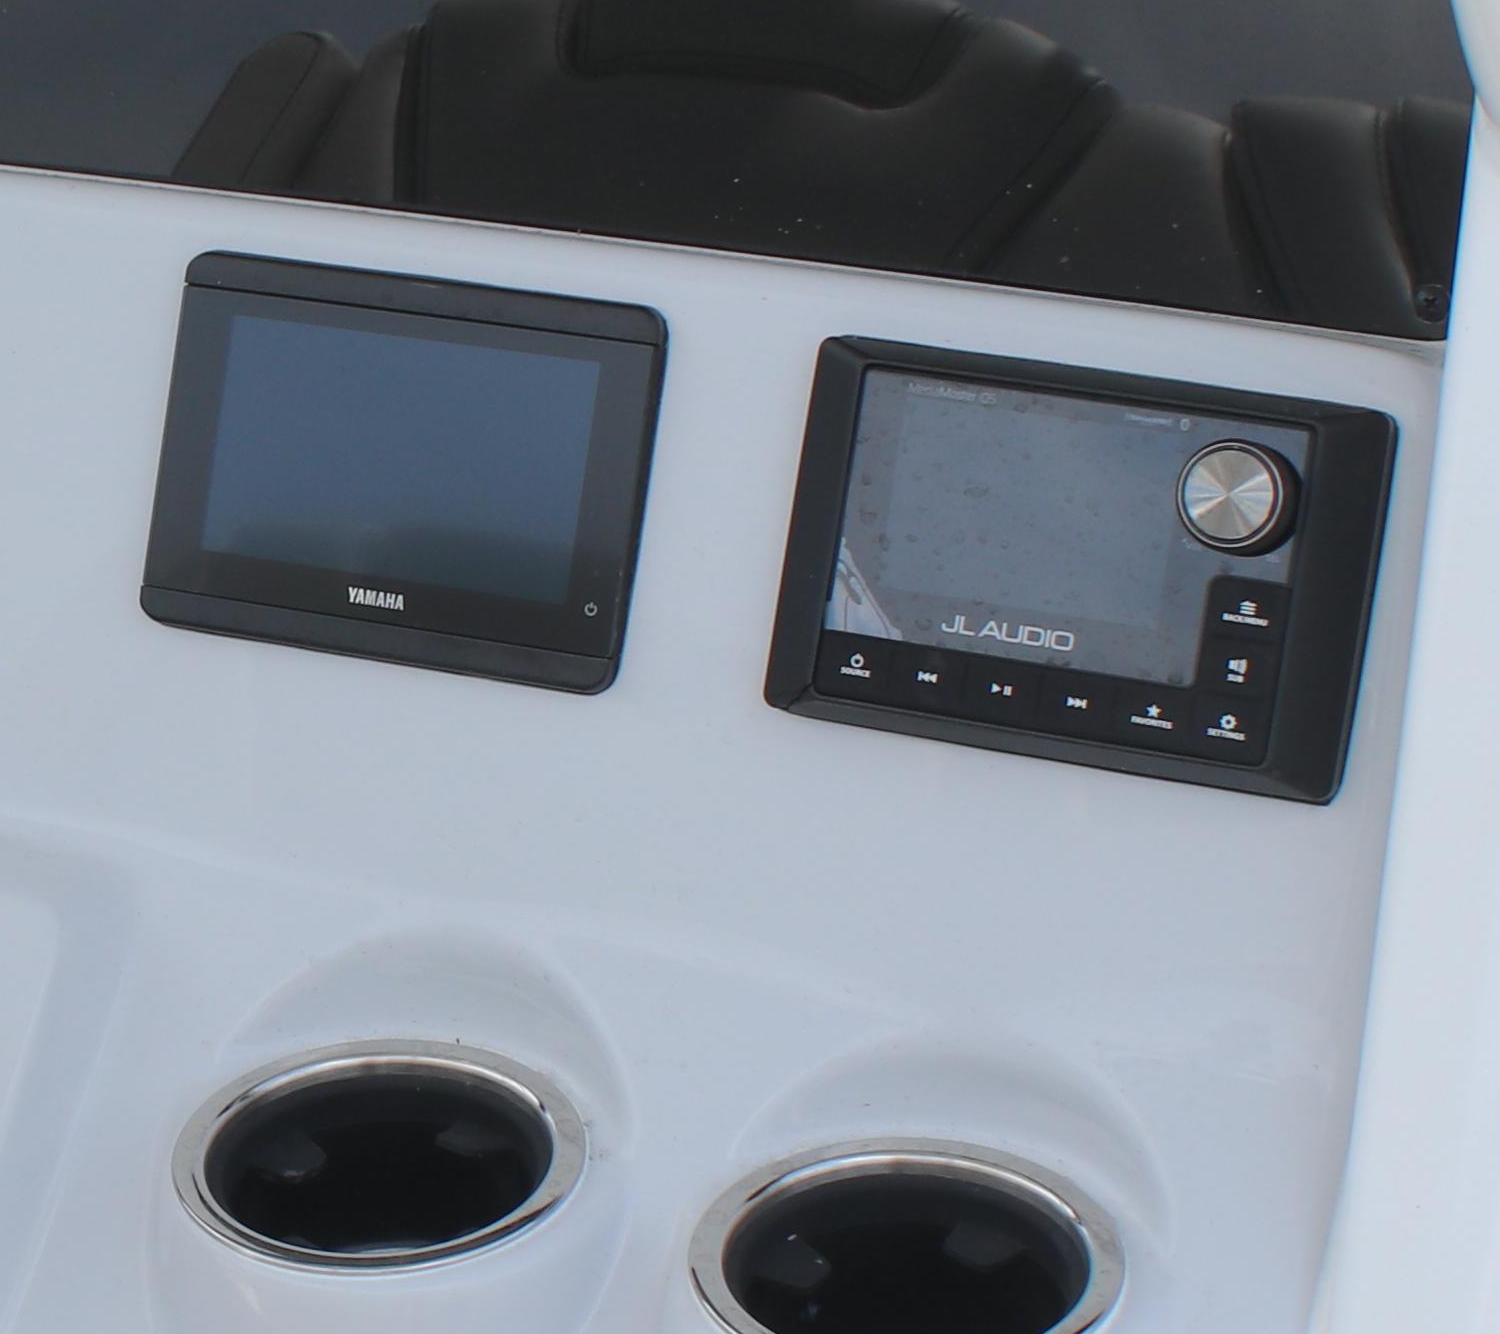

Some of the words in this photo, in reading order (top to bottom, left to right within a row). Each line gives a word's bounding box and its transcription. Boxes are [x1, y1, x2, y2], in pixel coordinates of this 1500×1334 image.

[348, 585, 405, 612] YAMAHA
[941, 614, 975, 636] JL
[978, 620, 1075, 652] AUDIO
[840, 666, 871, 679] SOURCE
[1131, 715, 1173, 730] FAVORITES
